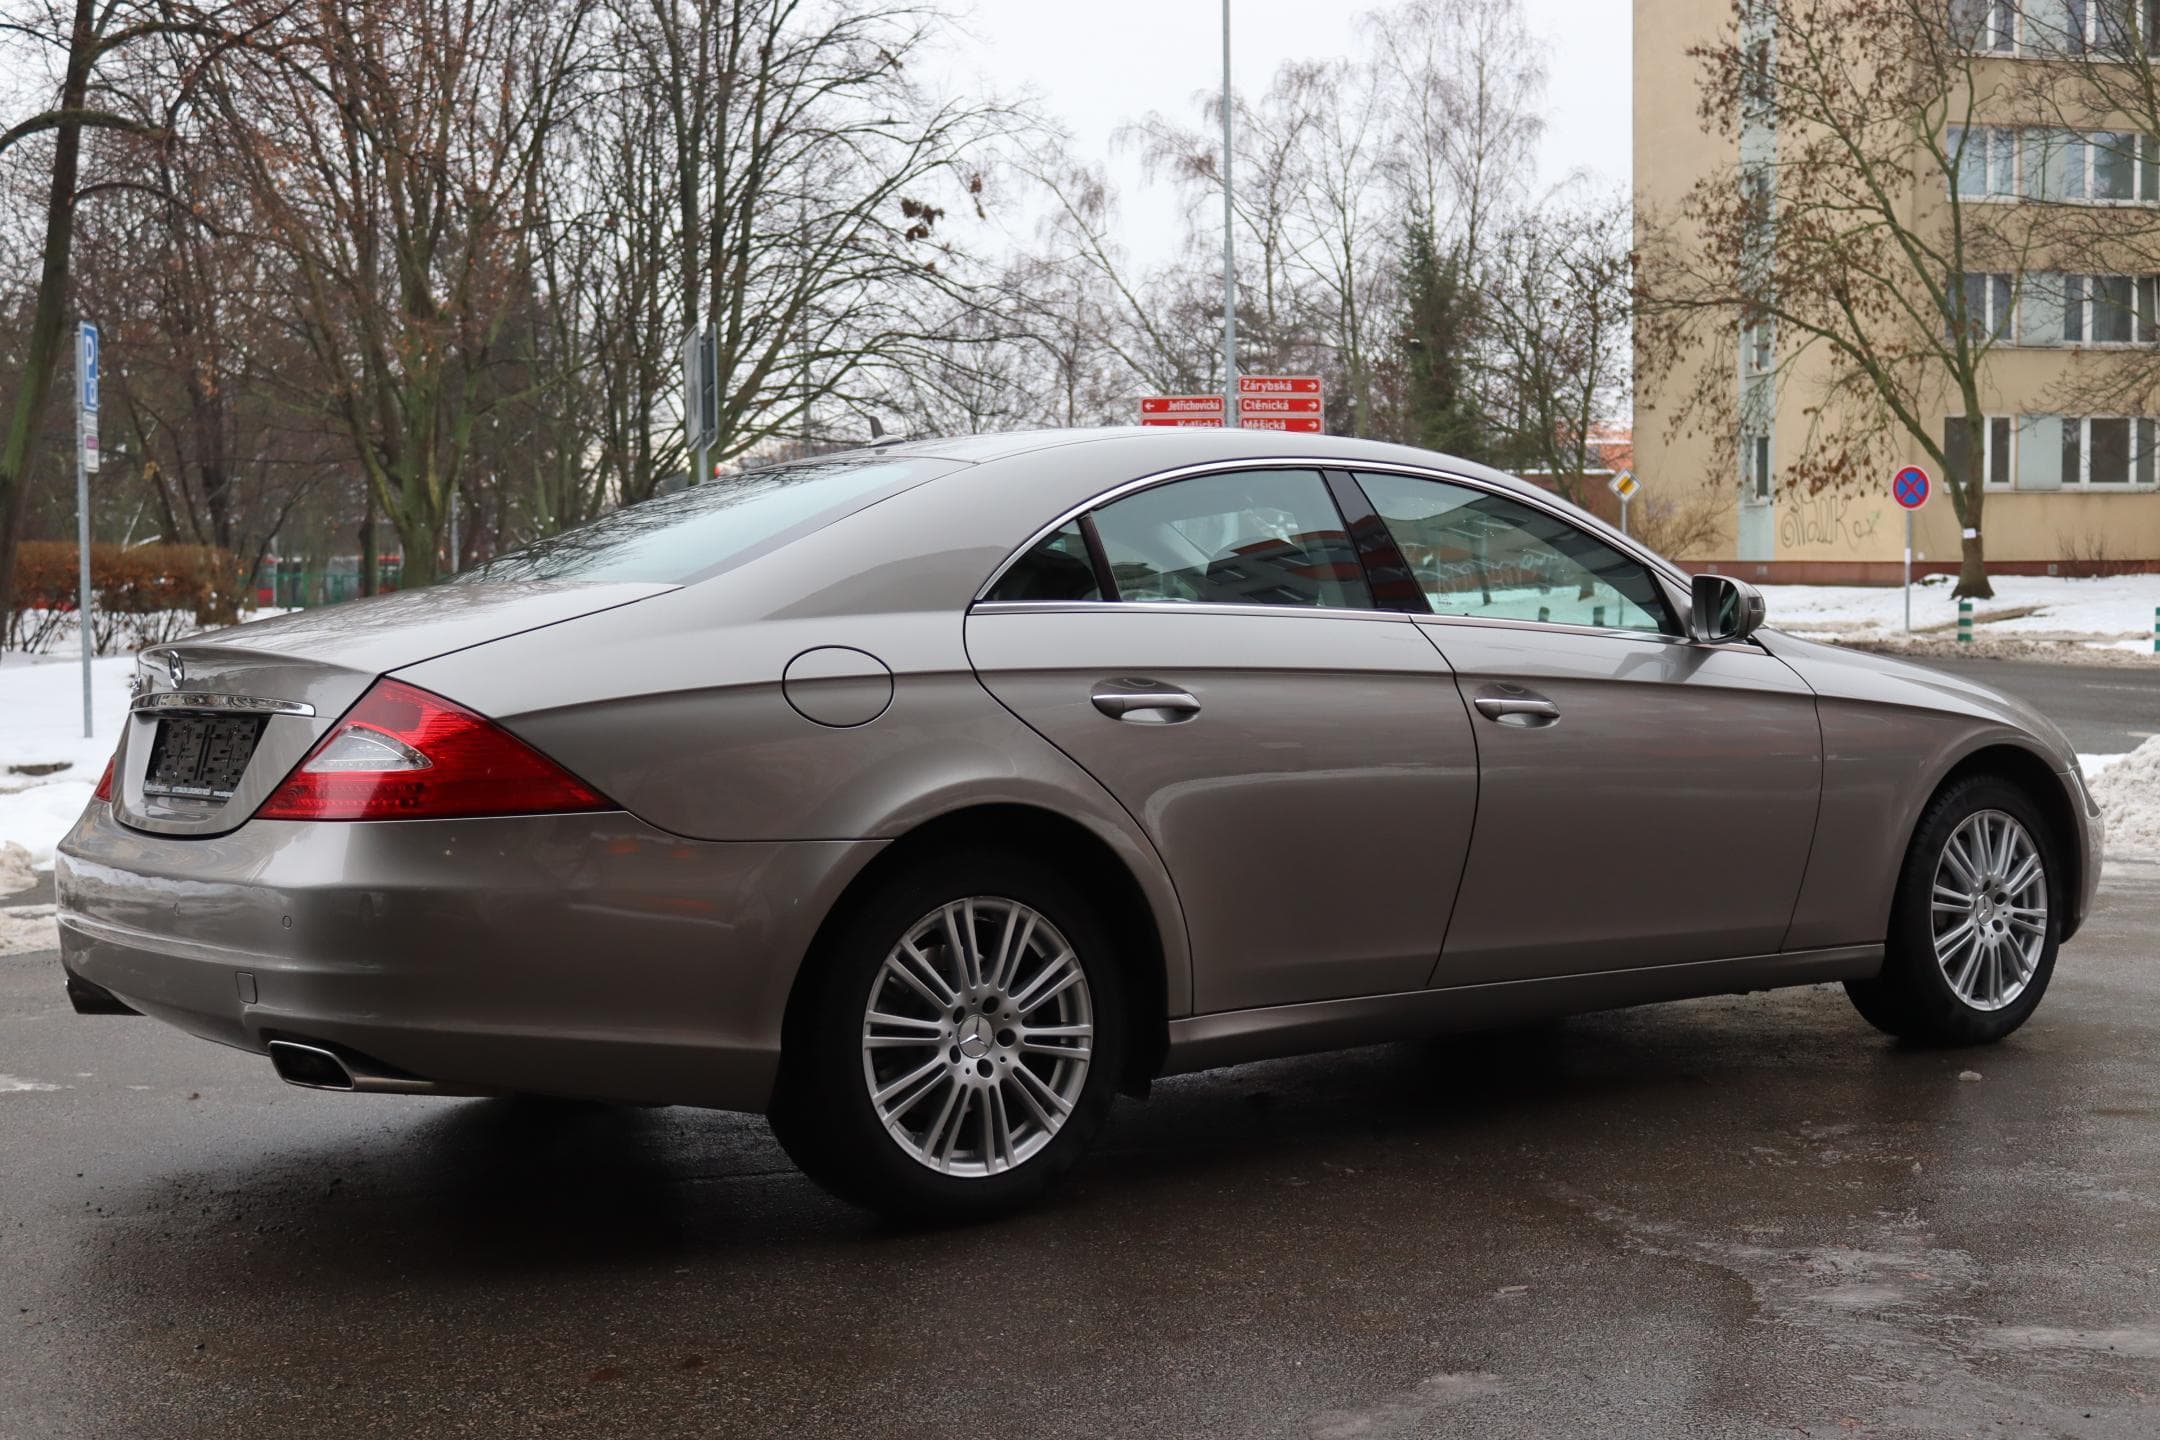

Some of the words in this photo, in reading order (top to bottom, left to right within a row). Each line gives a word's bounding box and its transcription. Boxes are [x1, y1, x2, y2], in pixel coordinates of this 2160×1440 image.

[86, 335, 95, 365] P
[1243, 380, 1292, 392] Zárybská
[1168, 400, 1220, 411] Jetřichovická
[1243, 400, 1289, 411] Ctěnická
[1243, 420, 1287, 430] Měšická
